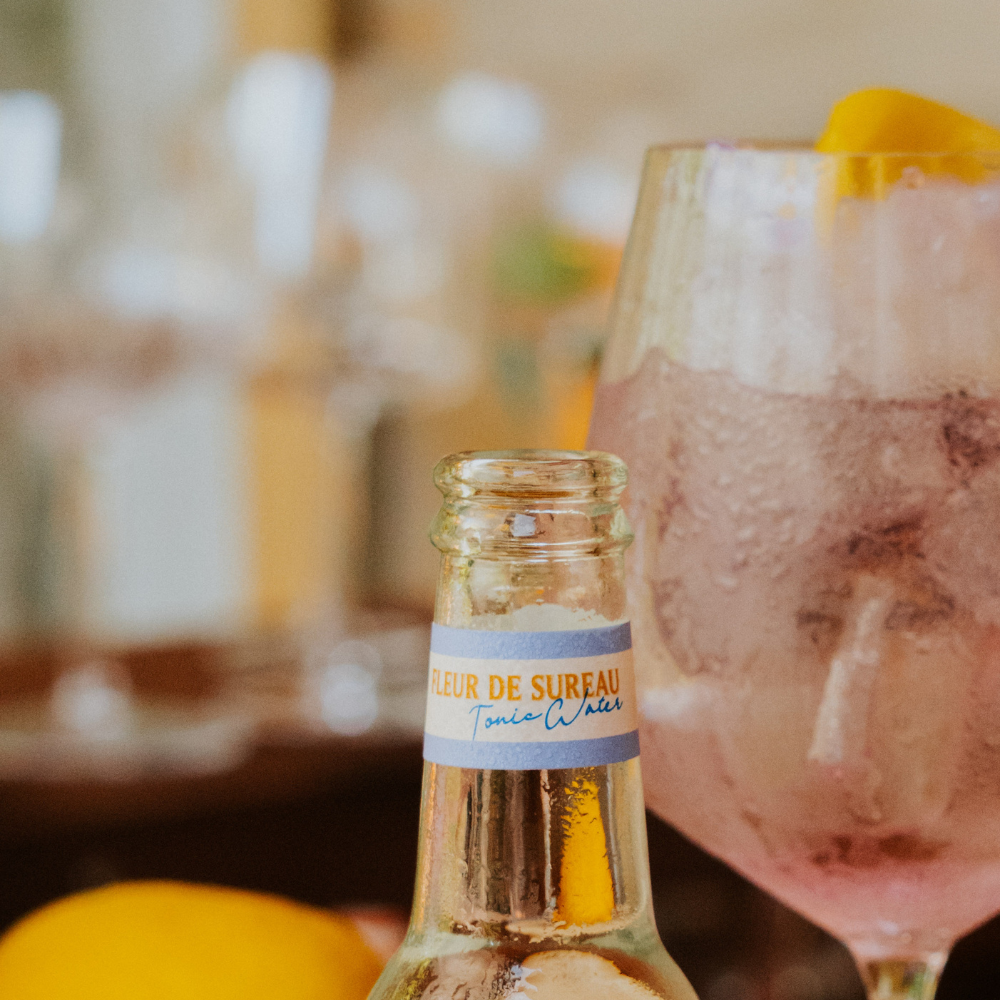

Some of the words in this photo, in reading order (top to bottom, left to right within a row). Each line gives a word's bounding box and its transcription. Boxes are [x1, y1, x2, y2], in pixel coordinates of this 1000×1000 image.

[431, 668, 479, 700] FLEUR
[488, 674, 522, 701] DE
[531, 668, 620, 701] SUREAU
[469, 704, 542, 741] Tonic
[545, 687, 623, 730] Water
